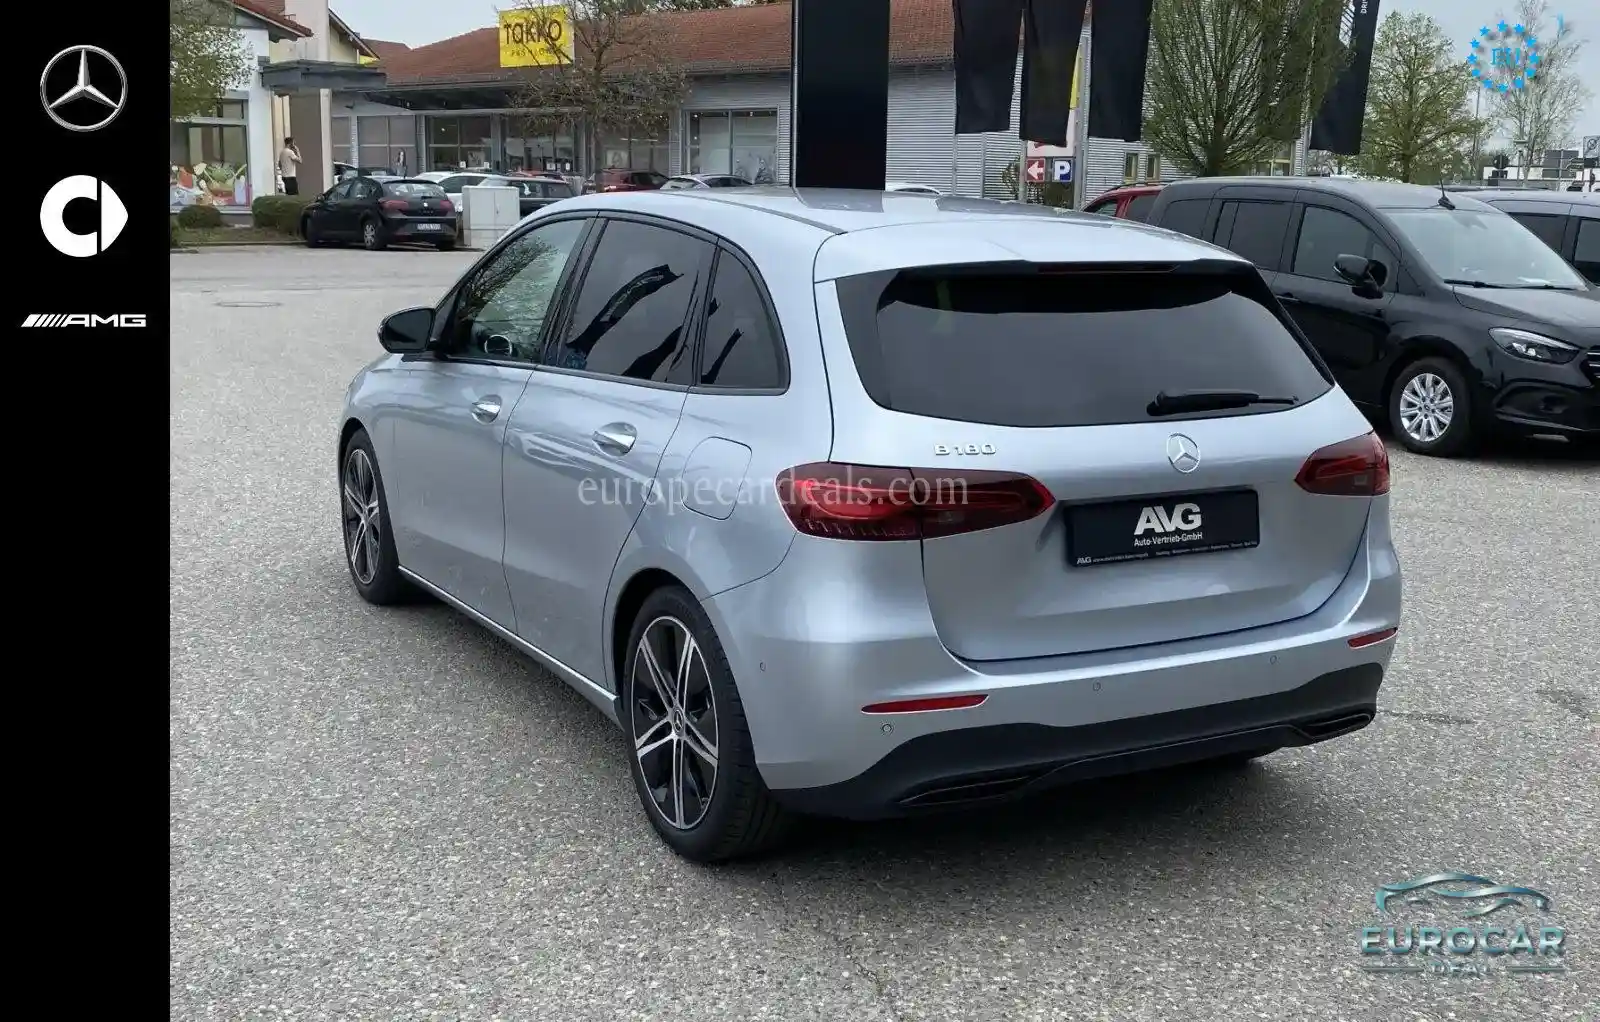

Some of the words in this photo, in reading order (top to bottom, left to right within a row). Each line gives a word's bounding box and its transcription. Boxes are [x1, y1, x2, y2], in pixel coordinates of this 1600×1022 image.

[1054, 160, 1071, 180] P
[934, 443, 951, 456] B
[953, 442, 997, 456] 180
[1134, 502, 1202, 536] AVG
[1134, 532, 1203, 548] Auto-Vertrieb-GmbH
